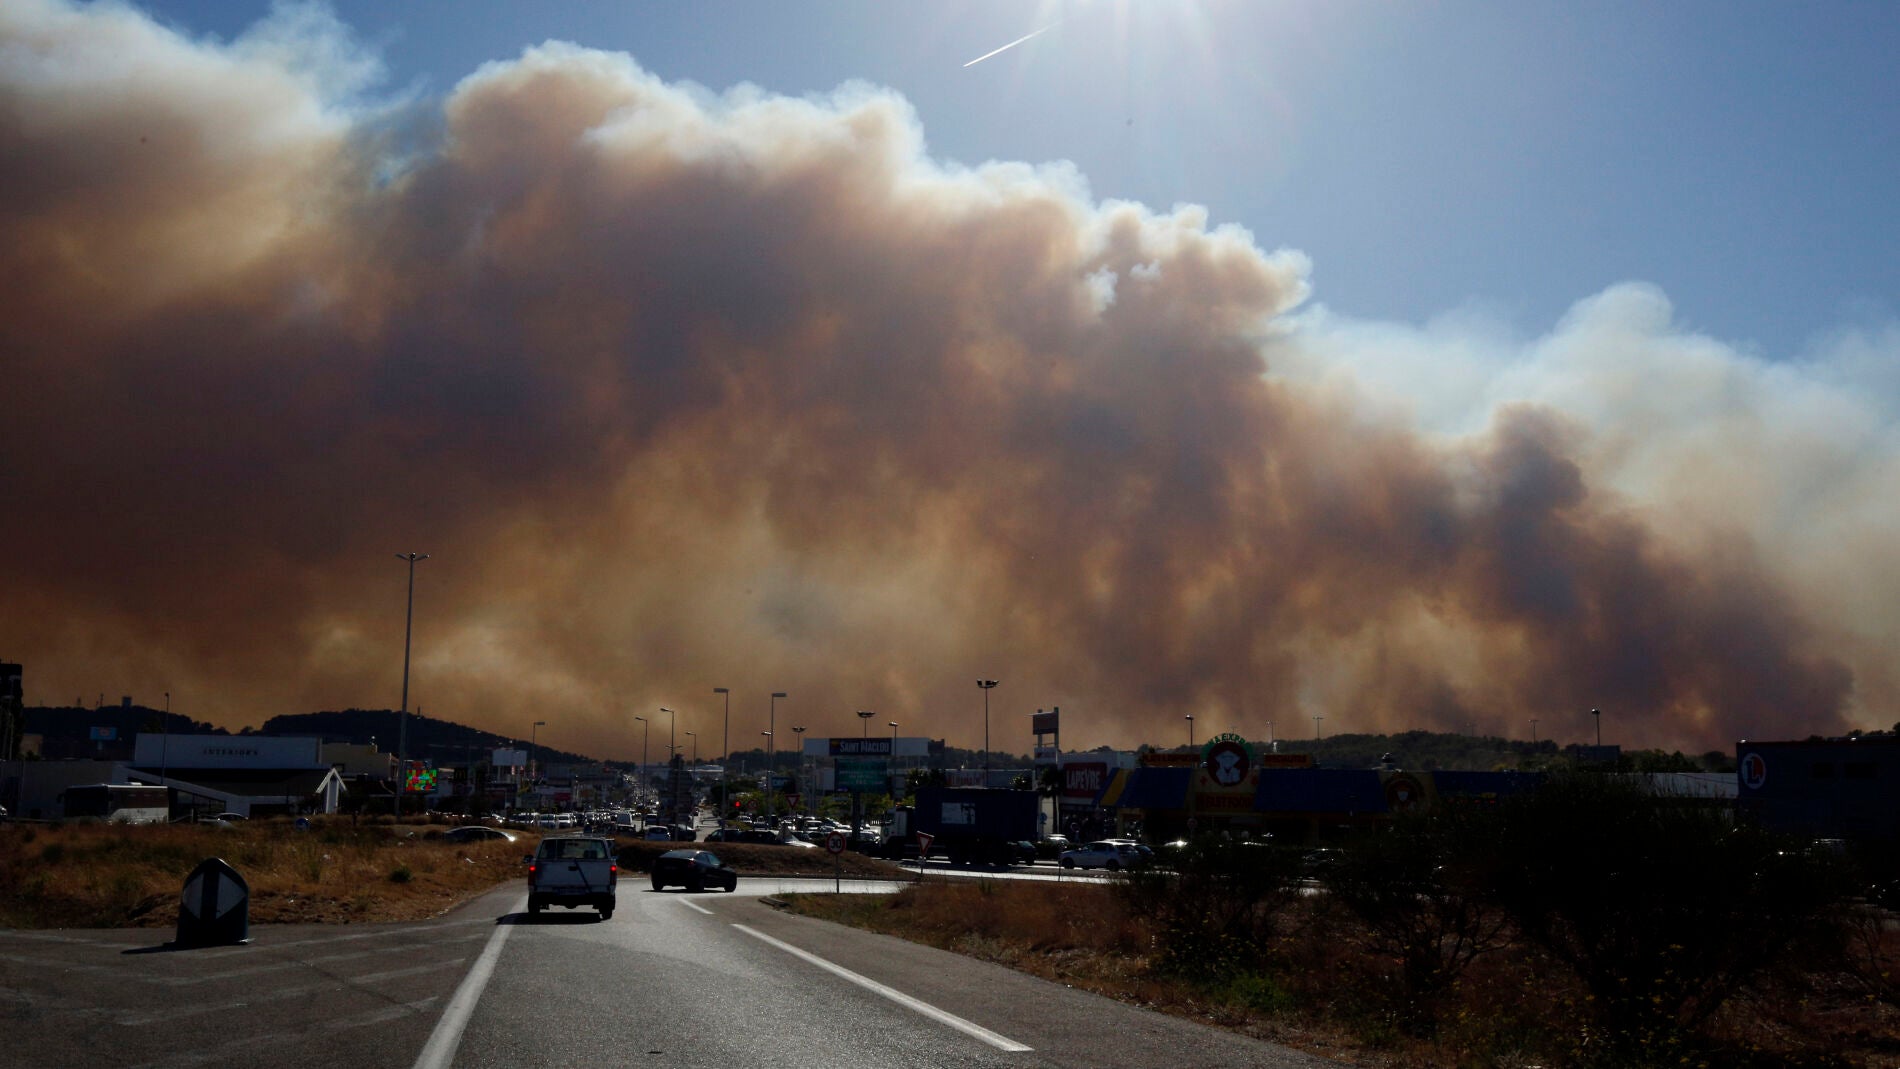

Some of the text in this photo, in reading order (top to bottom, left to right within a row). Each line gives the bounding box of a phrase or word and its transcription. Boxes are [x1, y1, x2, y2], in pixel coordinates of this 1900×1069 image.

[840, 740, 890, 753] SAINT MACLOU
[1066, 769, 1101, 791] LAPEYRE
[831, 838, 842, 849] 30
